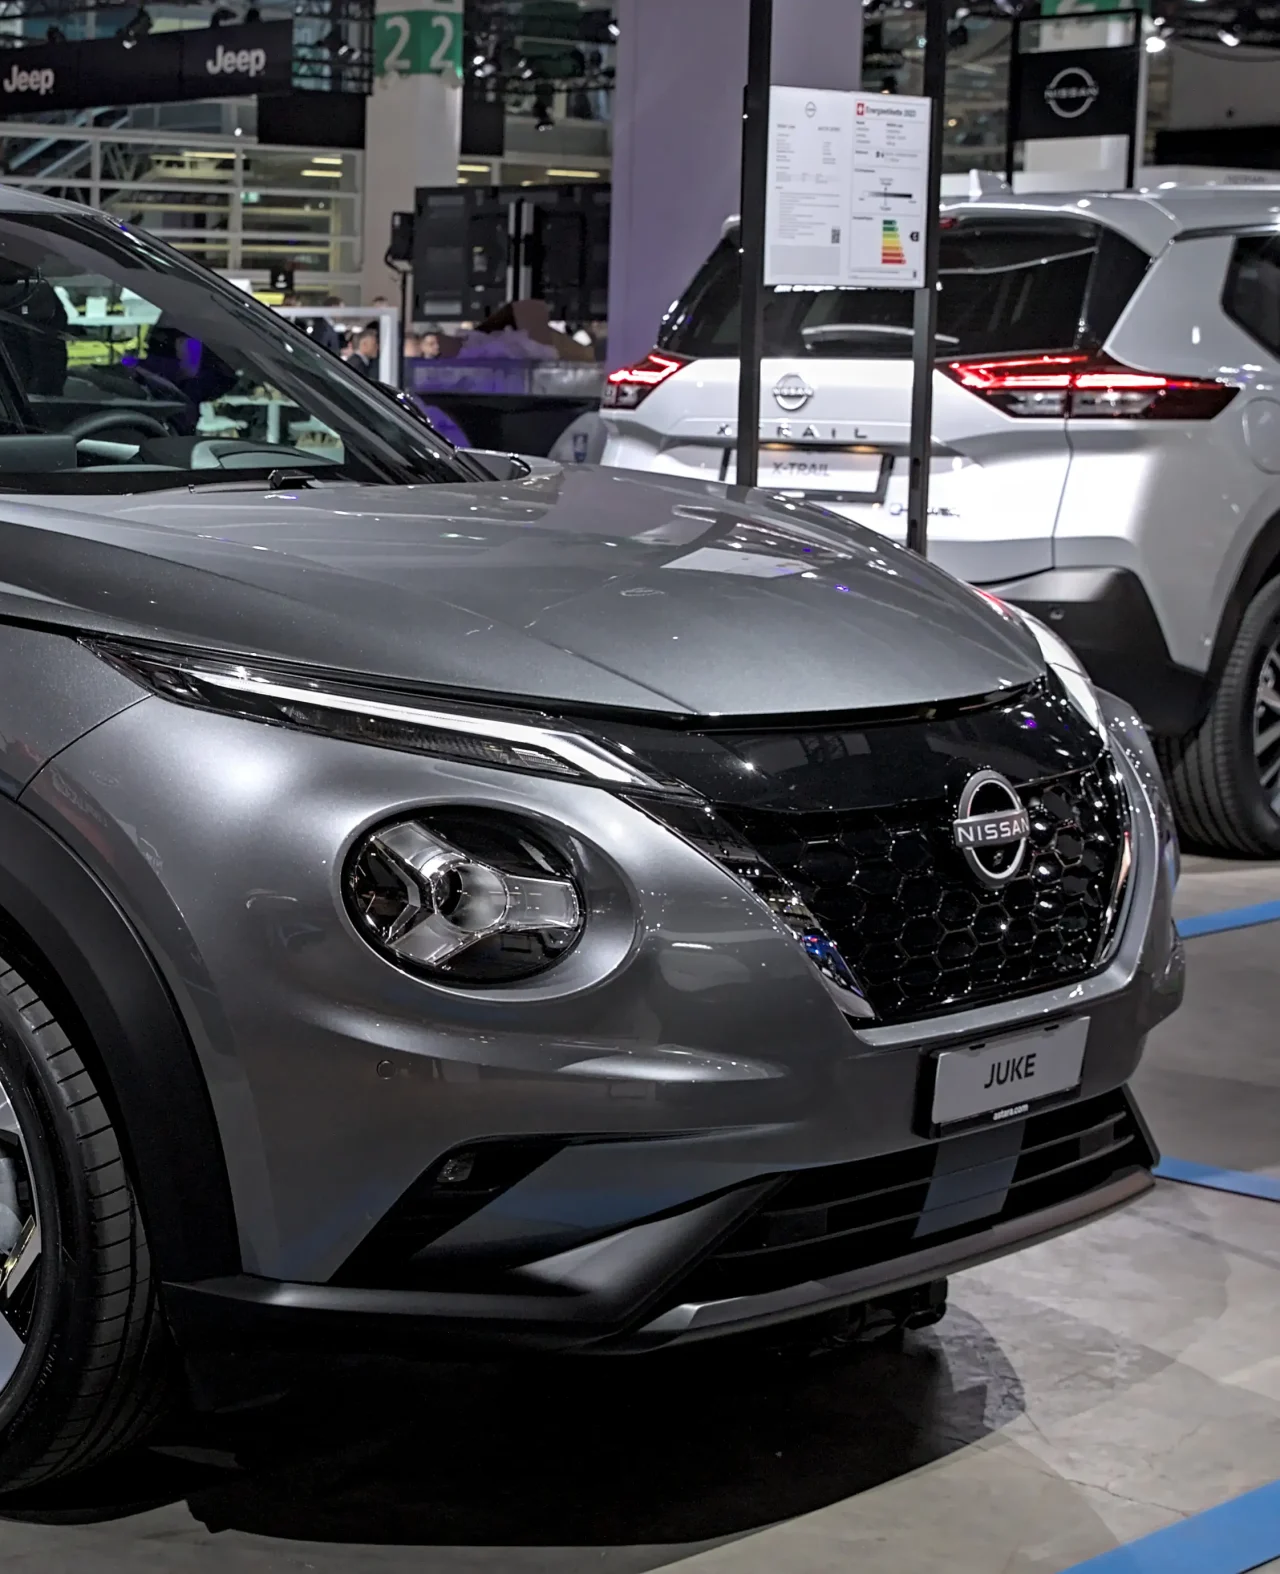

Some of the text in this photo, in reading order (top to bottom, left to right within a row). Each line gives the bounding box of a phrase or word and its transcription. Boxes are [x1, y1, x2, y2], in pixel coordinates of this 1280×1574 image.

[206, 44, 267, 78] Jeep
[3, 64, 55, 96] Jeep
[1043, 84, 1100, 101] NISSAN
[772, 461, 831, 477] X-TRAIL
[956, 815, 1030, 844] NISSAN
[983, 1052, 1037, 1090] JUKE
